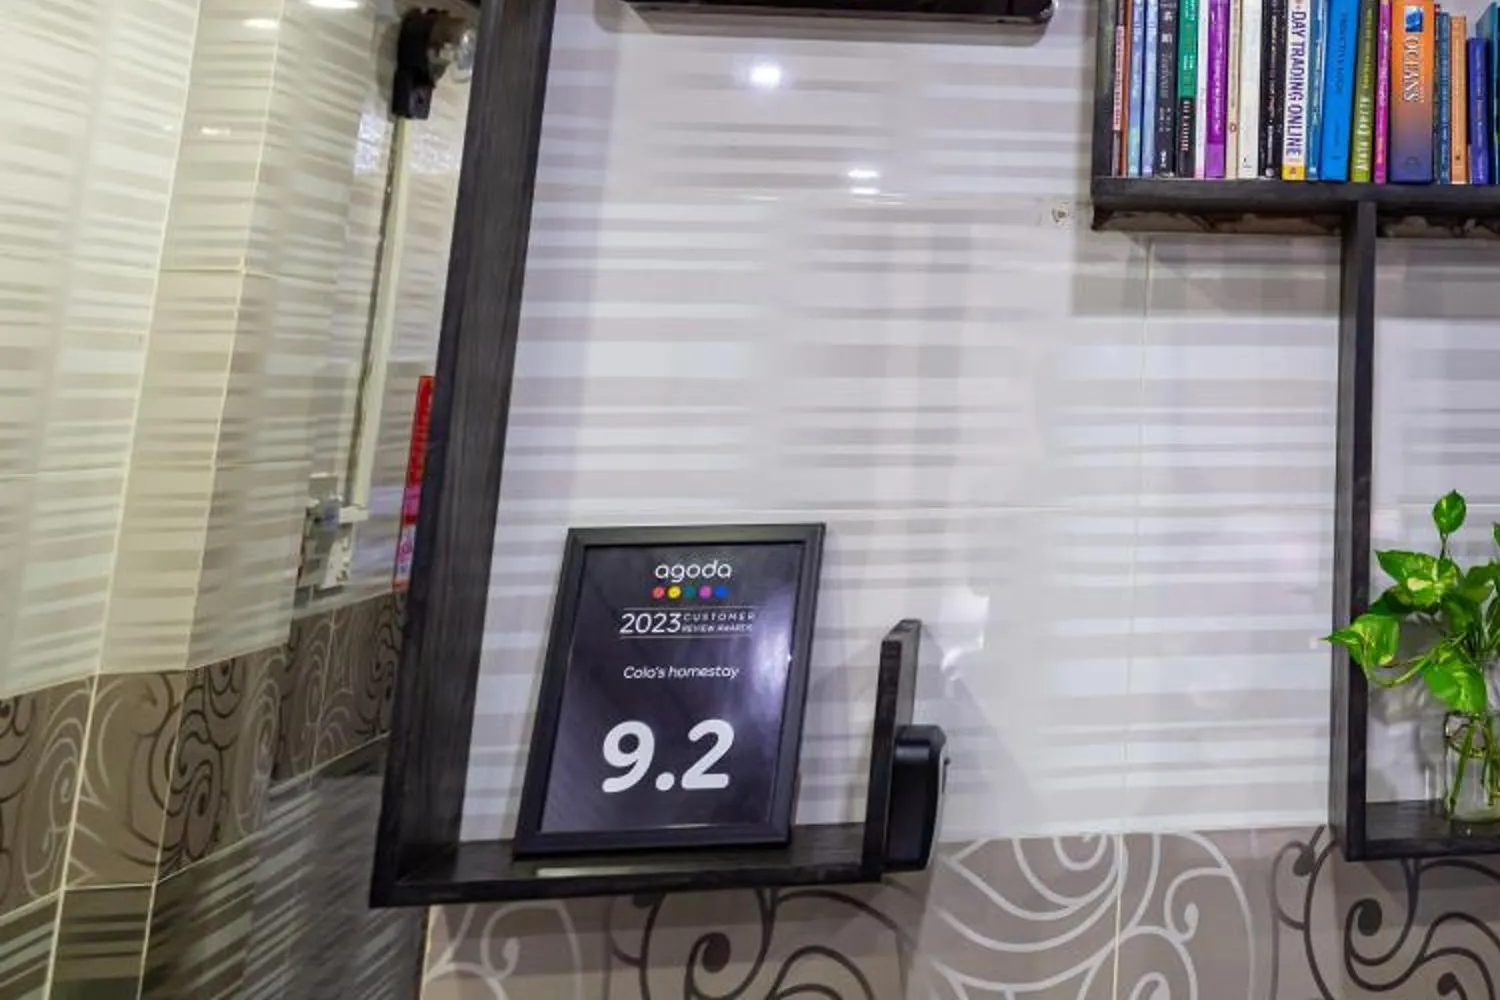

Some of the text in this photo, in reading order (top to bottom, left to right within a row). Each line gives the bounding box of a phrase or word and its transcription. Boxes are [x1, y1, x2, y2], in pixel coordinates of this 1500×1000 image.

[1291, 11, 1308, 42] DAY
[1288, 41, 1307, 104] TRADING
[1403, 35, 1420, 102] OCEANS
[1285, 104, 1305, 157] ONLINE
[655, 560, 733, 583] agoda
[619, 613, 682, 634] 2023
[683, 611, 755, 622] CUSTOMER
[668, 666, 740, 680] homestay
[602, 719, 735, 793] 9.2
